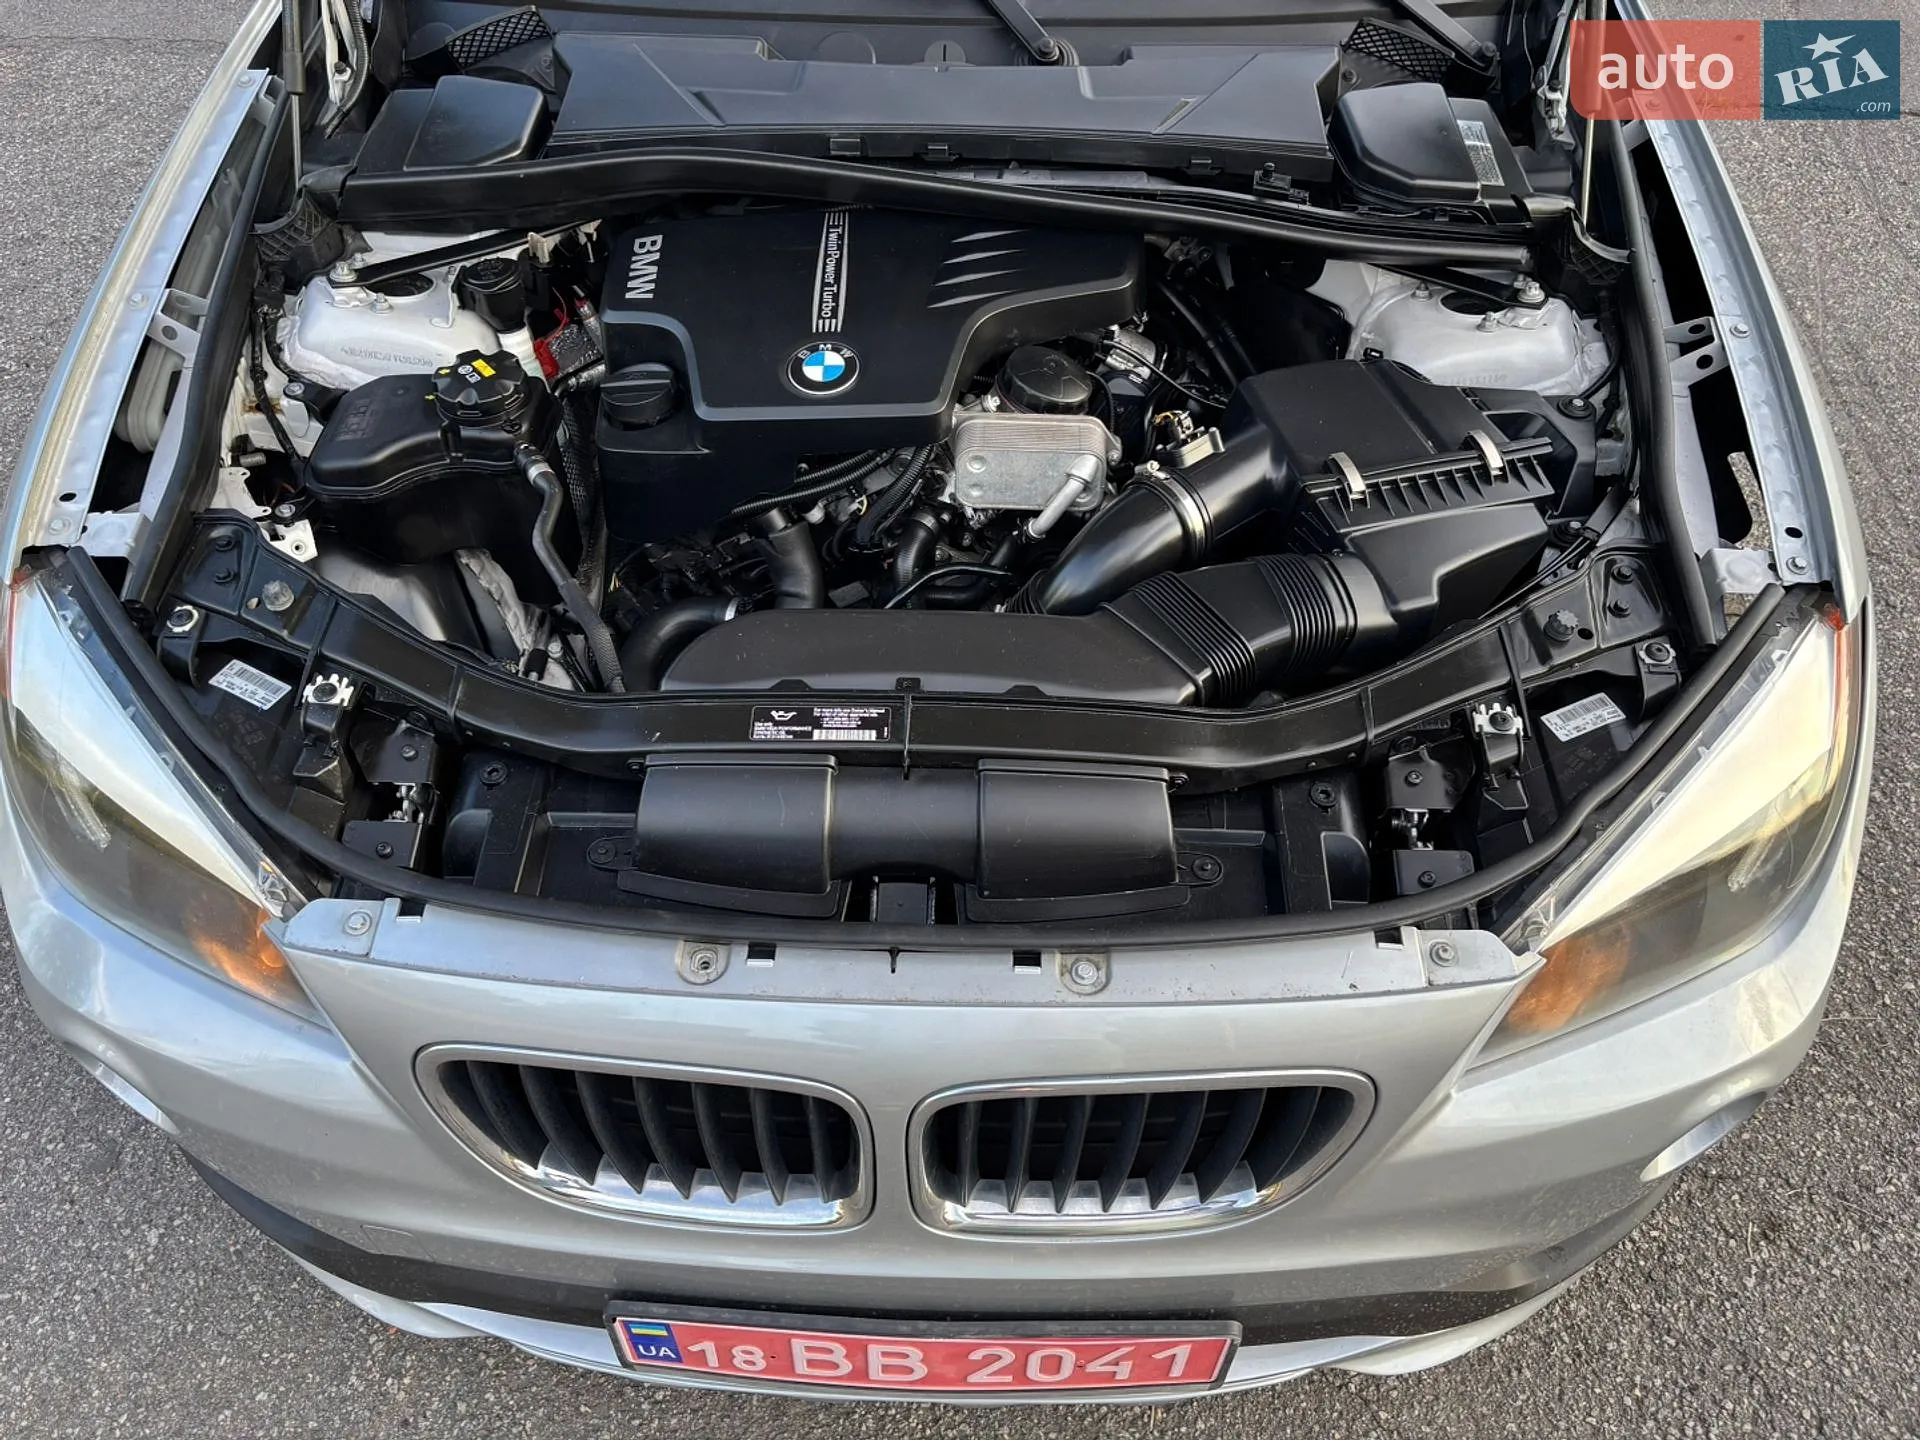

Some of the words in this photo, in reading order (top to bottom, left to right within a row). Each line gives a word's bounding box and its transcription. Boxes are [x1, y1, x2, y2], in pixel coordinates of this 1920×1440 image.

[625, 234, 663, 299] BMW
[820, 284, 839, 318] Turbo
[797, 343, 854, 359] BMW
[638, 1343, 677, 1360] UA
[687, 1340, 767, 1372] 18
[790, 1338, 929, 1382] BB
[966, 1343, 1193, 1384] 2041
